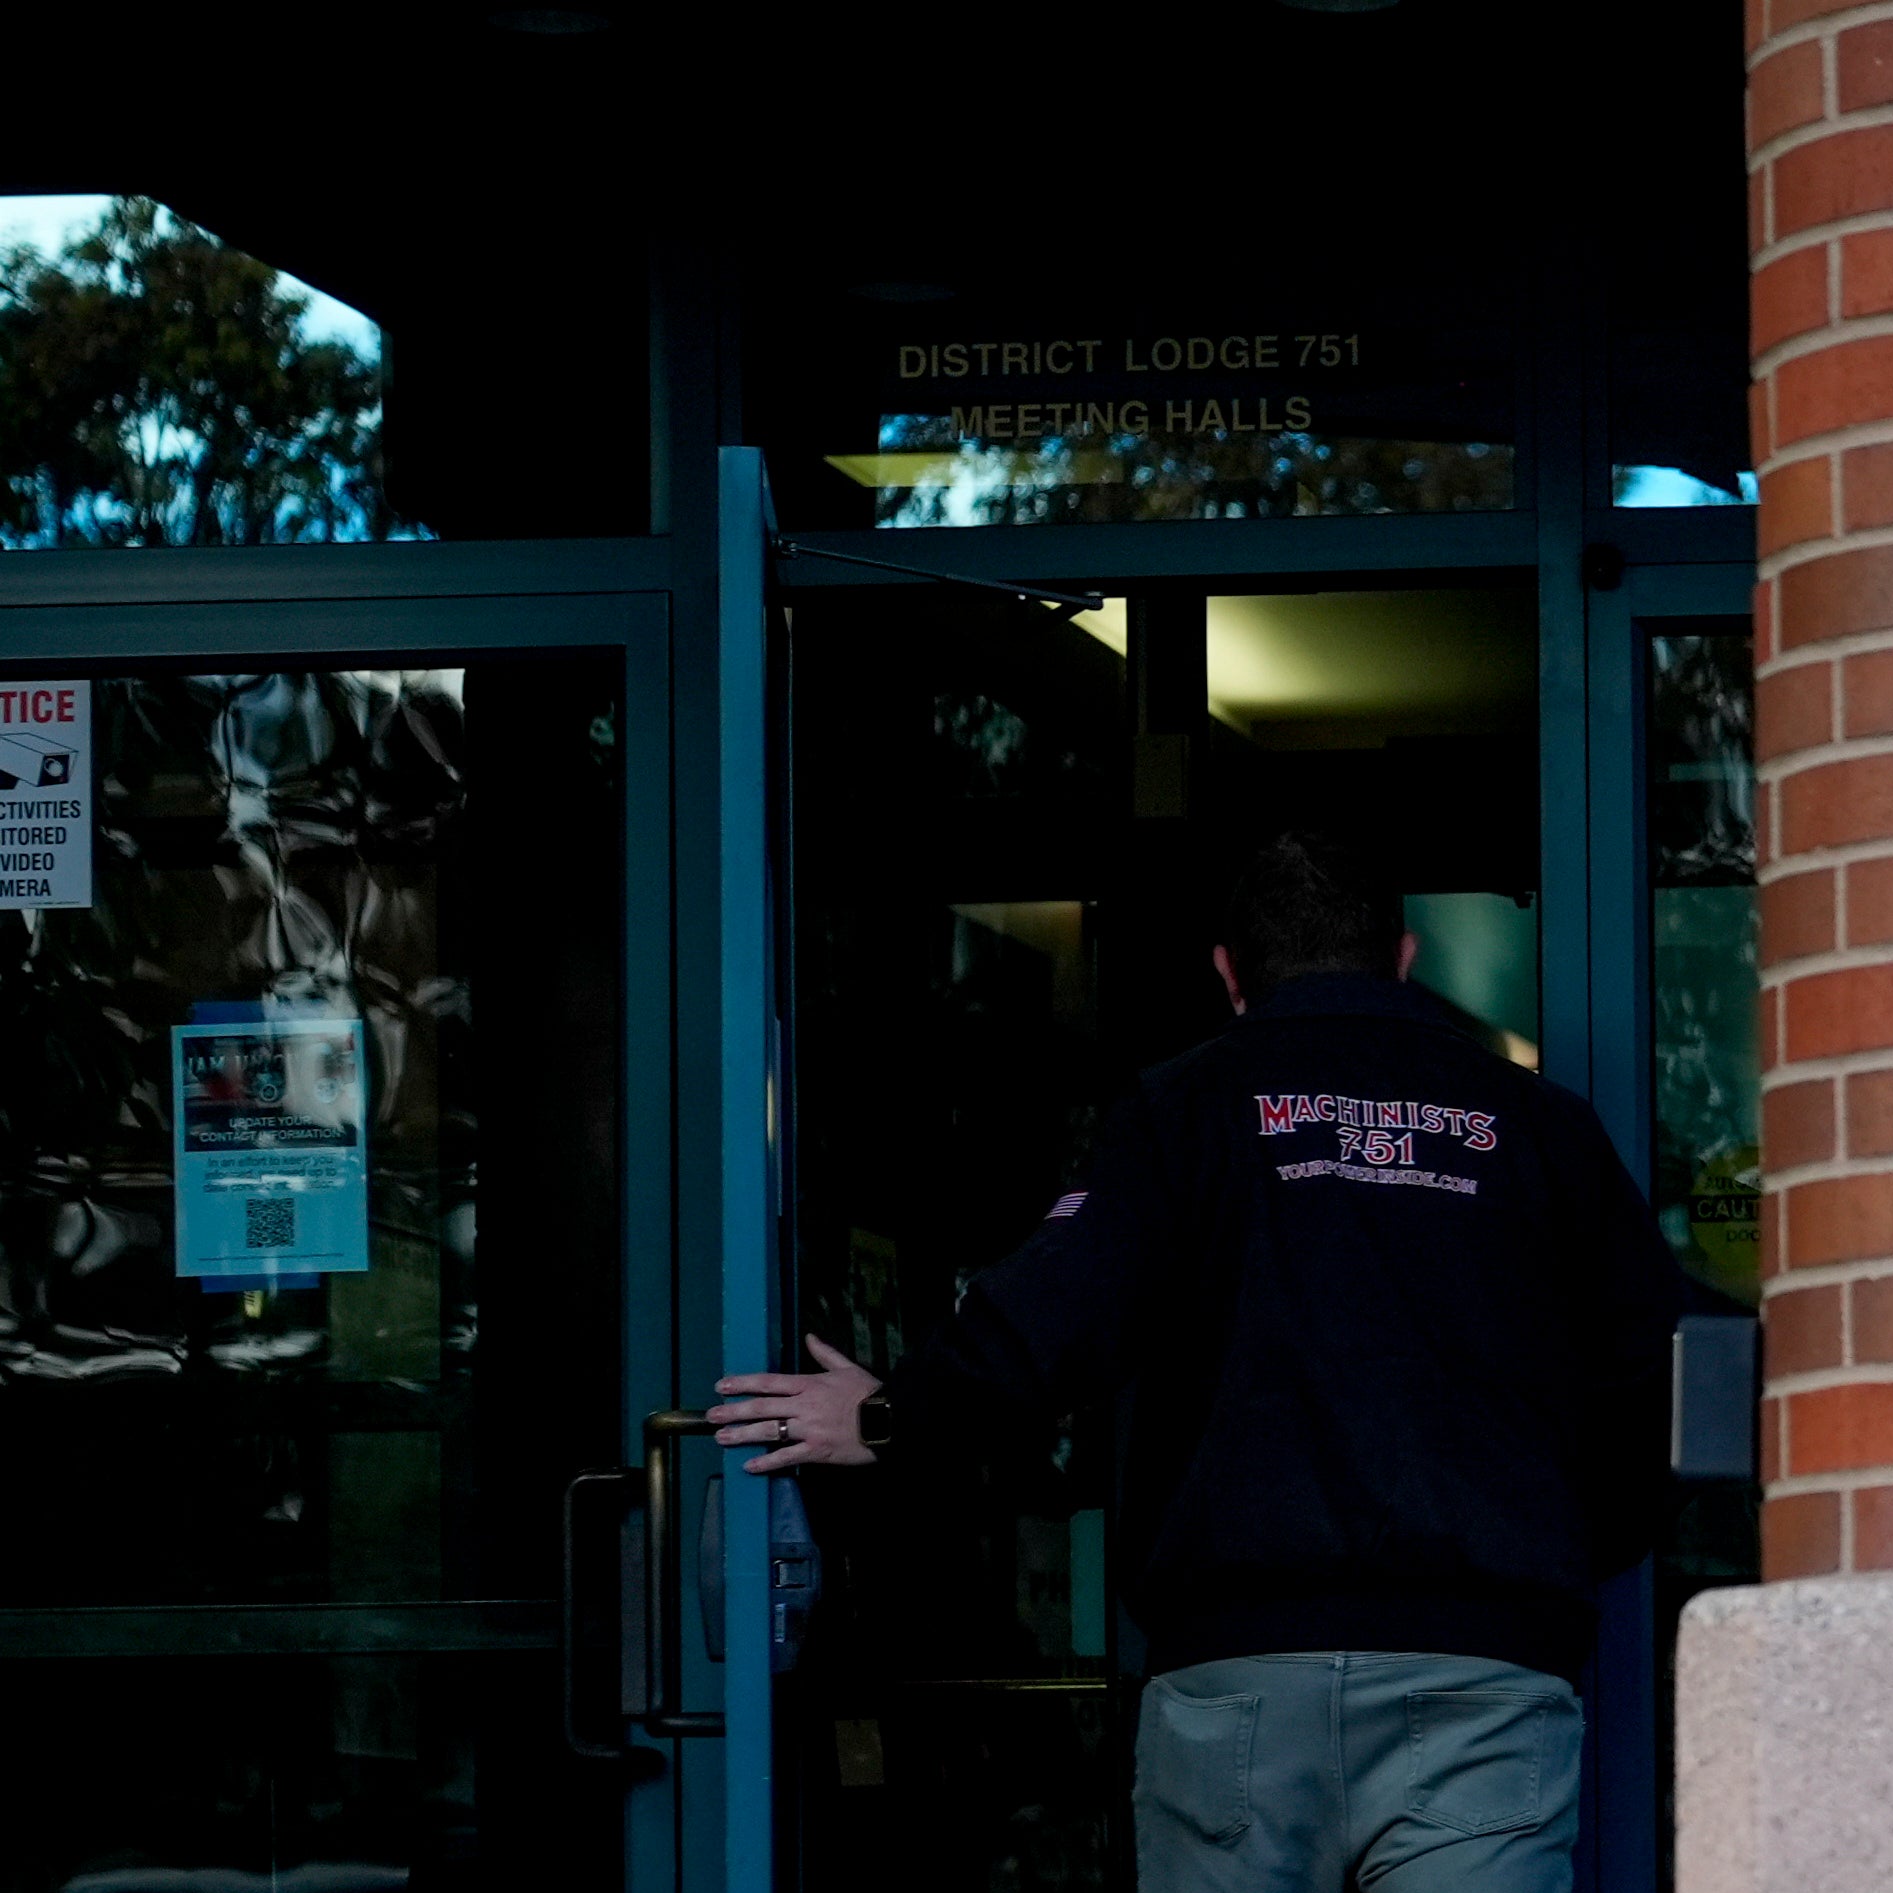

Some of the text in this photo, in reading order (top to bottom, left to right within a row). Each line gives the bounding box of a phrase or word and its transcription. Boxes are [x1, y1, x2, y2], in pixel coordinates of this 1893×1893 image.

[897, 333, 1362, 380] DISTRICT LODGE 751
[951, 395, 1313, 440] MEETING HALLS
[0, 690, 75, 724] TICE
[0, 853, 55, 871] VIDEO
[0, 879, 51, 897] MERA
[200, 1130, 255, 1143] CONTACT
[229, 1115, 312, 1129] UPDATE YOUR
[1253, 1094, 1498, 1151] MACHINISTS
[1336, 1126, 1416, 1165] 751
